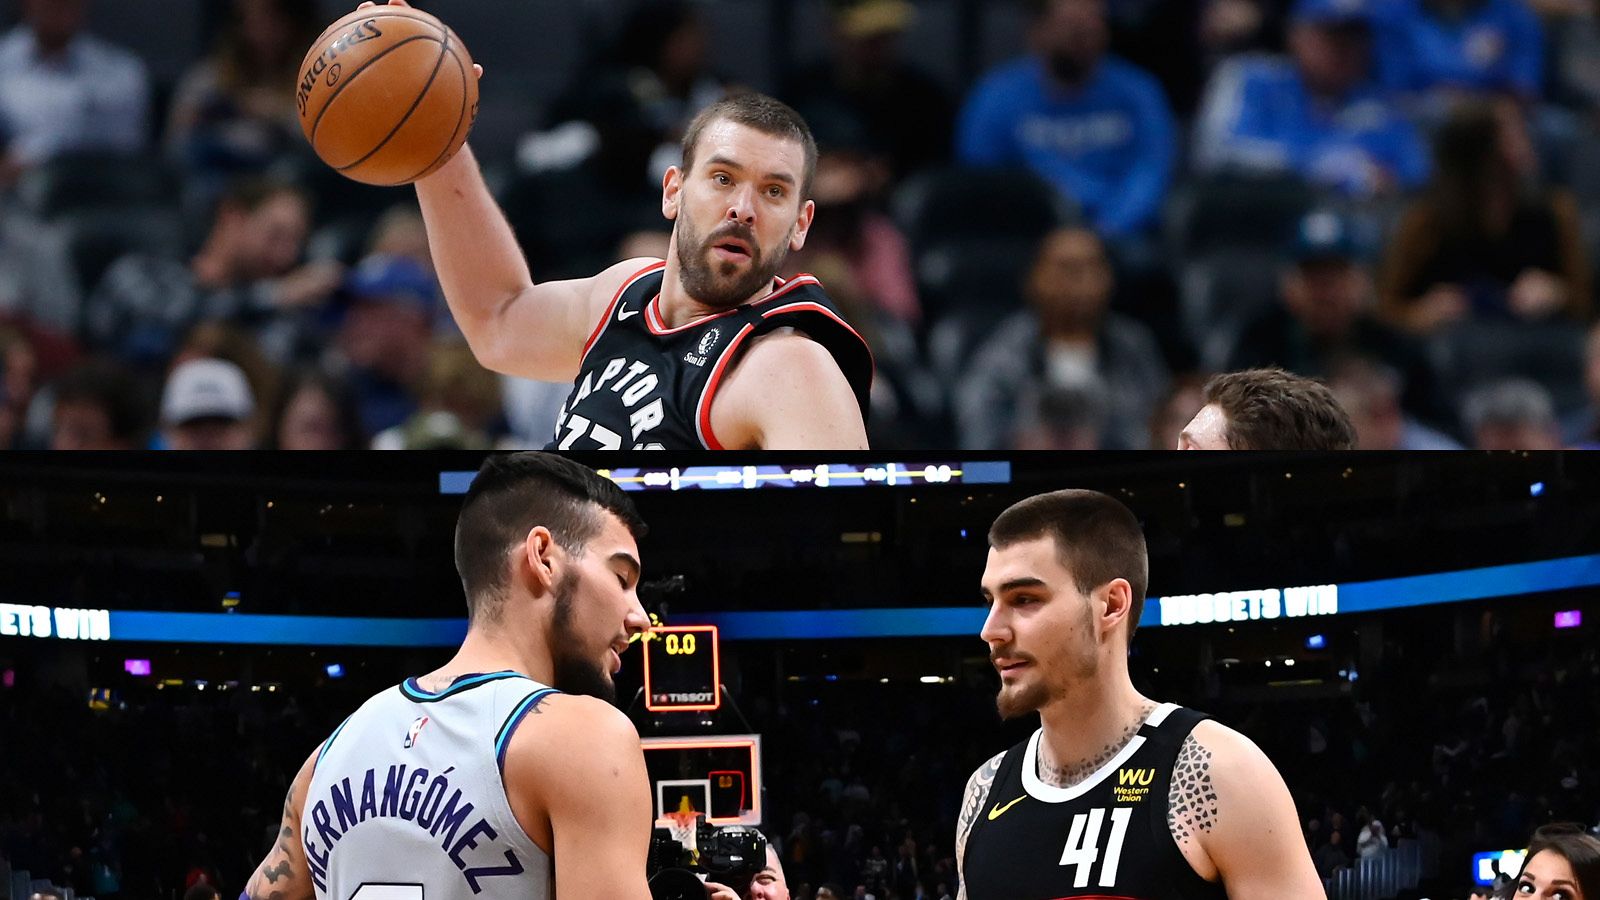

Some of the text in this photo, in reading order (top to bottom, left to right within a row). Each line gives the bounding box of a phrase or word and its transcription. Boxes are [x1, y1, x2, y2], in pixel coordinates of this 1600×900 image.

[298, 19, 381, 117] SPALDING
[1160, 584, 1338, 626] NUGGETS WIN
[54, 607, 110, 640] WIN
[665, 633, 695, 655] 0.0
[669, 692, 714, 702] TISSOT
[1113, 786, 1149, 794] Western
[1119, 768, 1155, 785] WU
[1117, 794, 1141, 802] Union
[304, 764, 524, 894] HERNANGÓMEZ
[1059, 807, 1133, 888] 41
